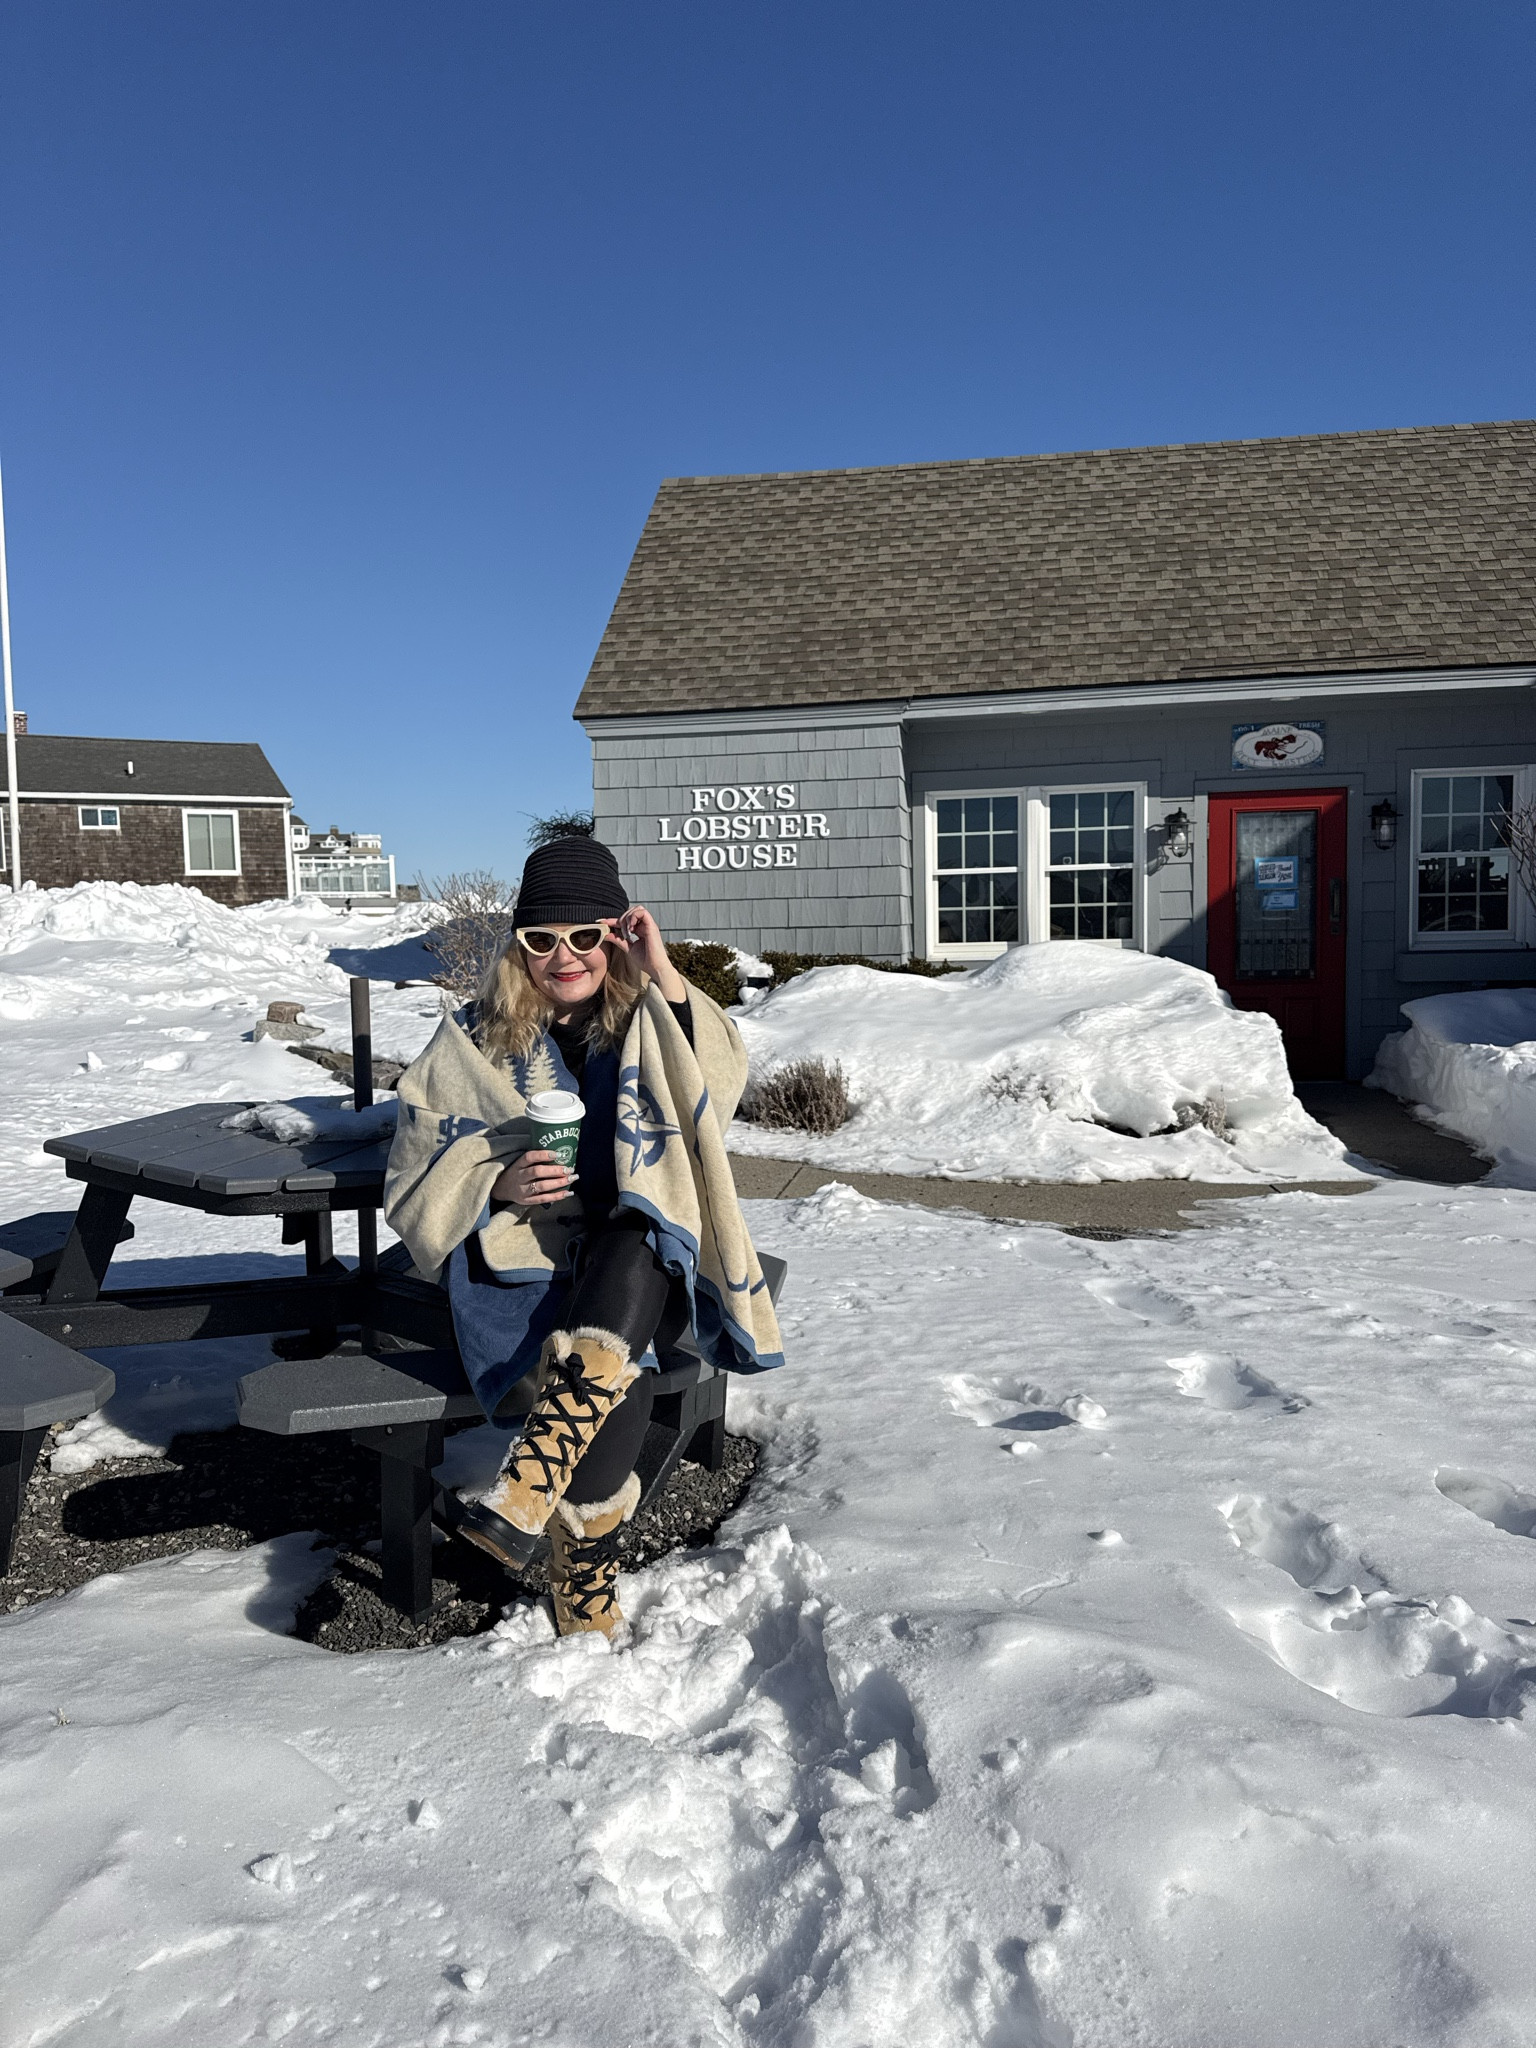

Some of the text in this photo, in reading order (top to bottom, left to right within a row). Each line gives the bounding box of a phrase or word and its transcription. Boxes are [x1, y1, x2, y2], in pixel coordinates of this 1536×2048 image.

[1263, 727, 1293, 736] MAINE
[1299, 721, 1320, 729] FRESH
[691, 784, 796, 812] FOX'S
[658, 813, 831, 842] LOBSTER
[677, 843, 797, 870] HOUSE
